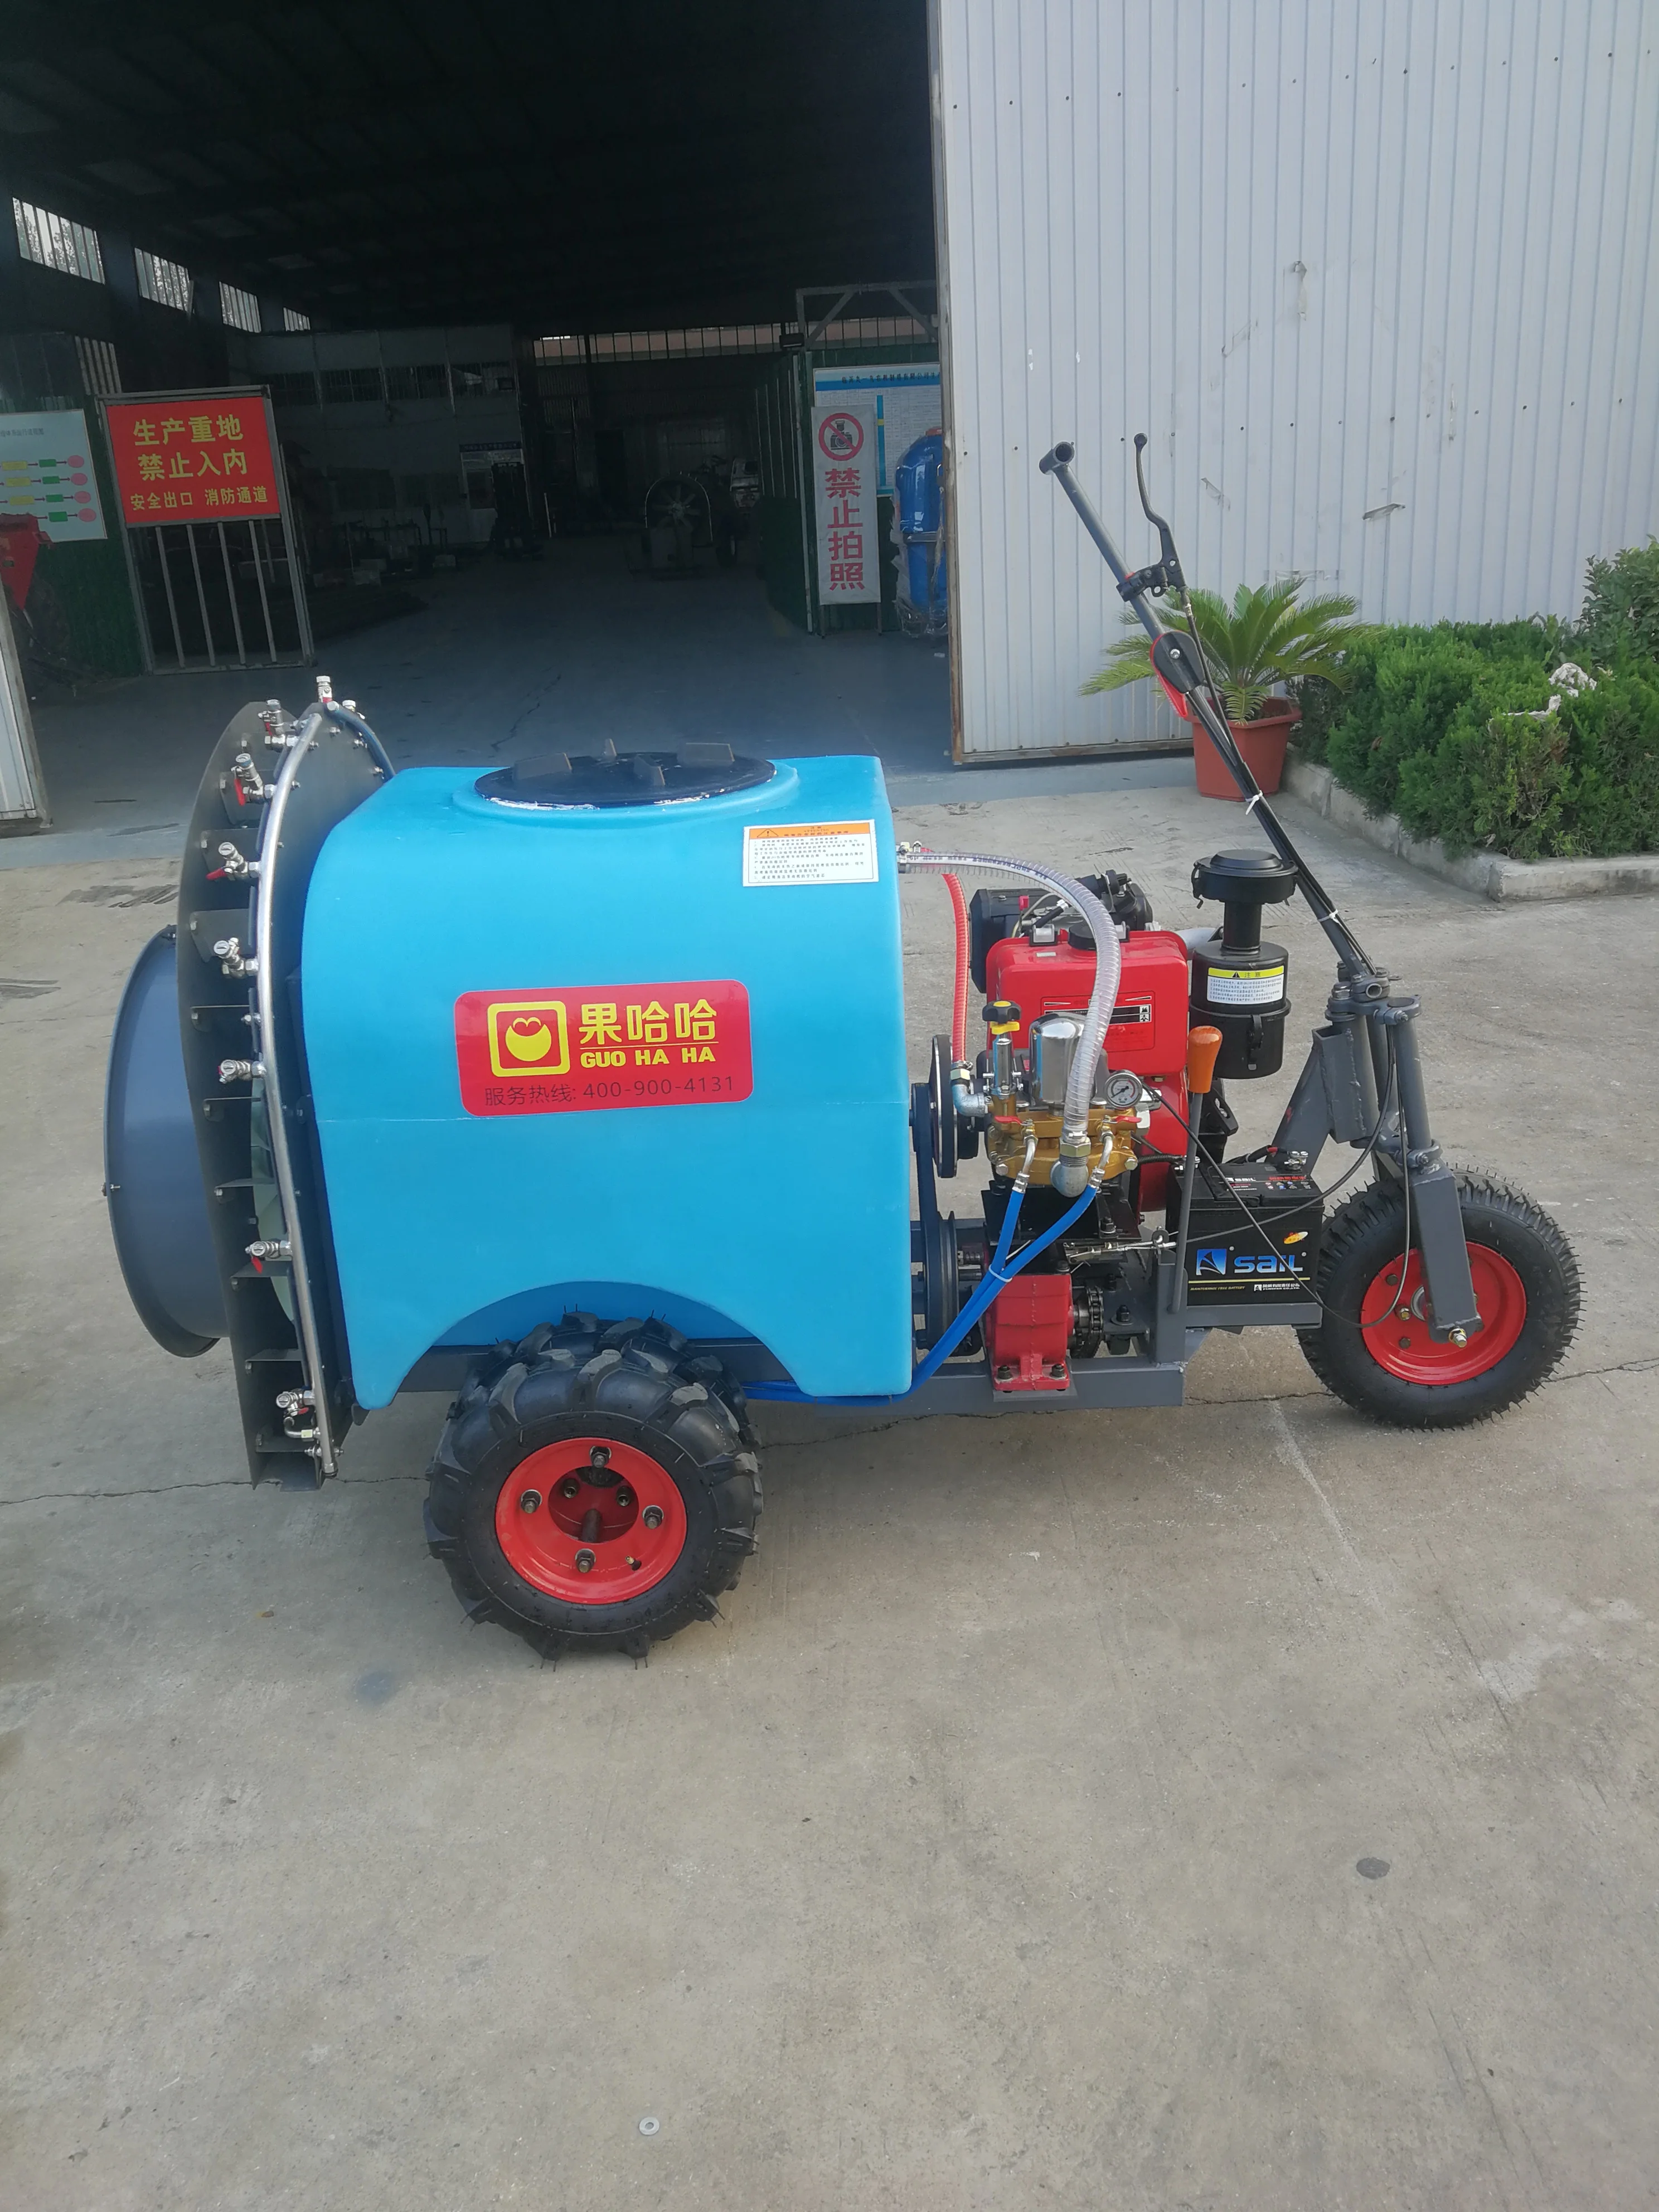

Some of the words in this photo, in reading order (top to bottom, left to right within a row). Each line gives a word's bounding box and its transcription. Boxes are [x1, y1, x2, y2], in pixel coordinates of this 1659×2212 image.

[133, 414, 244, 446] 生产重地
[138, 448, 248, 481] 禁止入内
[130, 491, 193, 511] 安全出口
[205, 486, 268, 506] 消防通道
[825, 467, 865, 591] 禁止拍照
[579, 998, 717, 1045] 果哈哈
[580, 1051, 627, 1069] GUO
[635, 1049, 670, 1066] HA
[682, 1046, 716, 1064] HA
[583, 1076, 734, 1099] 400-900-4131
